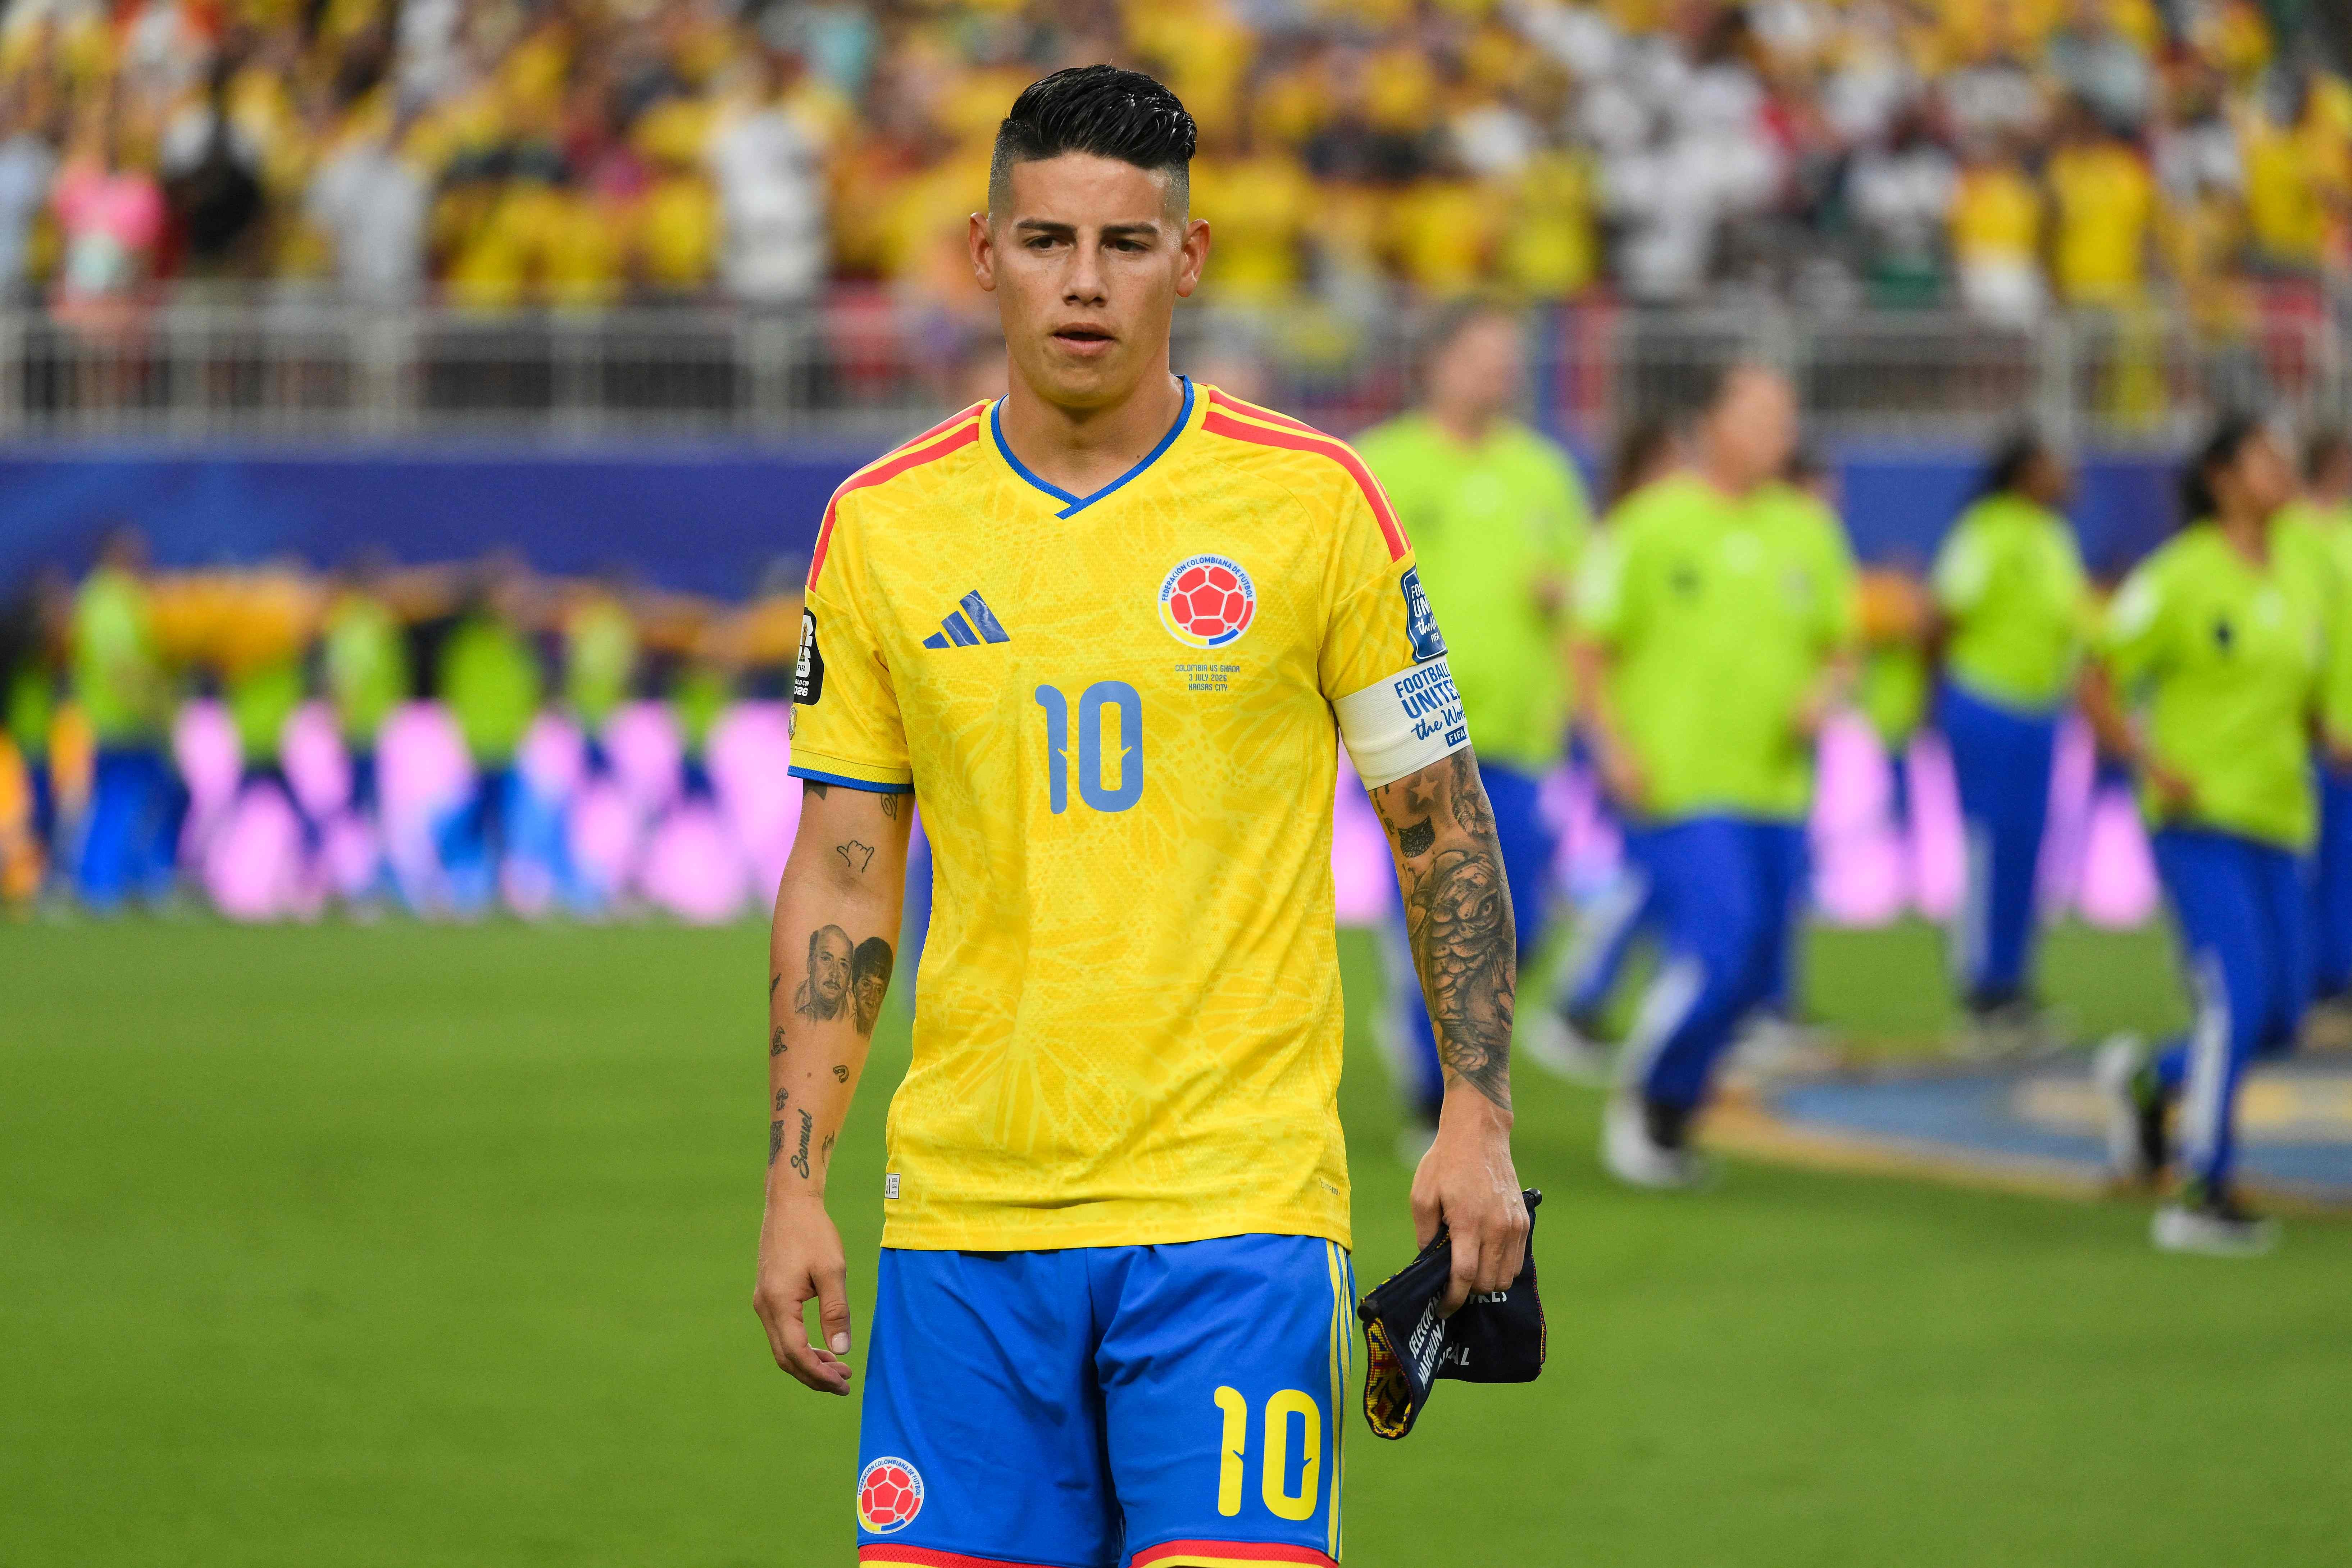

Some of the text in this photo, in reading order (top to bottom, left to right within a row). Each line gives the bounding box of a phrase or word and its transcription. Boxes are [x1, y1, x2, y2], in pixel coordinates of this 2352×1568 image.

[1187, 557, 1232, 569] COLOMBIANA
[1232, 566, 1241, 575] DE
[1430, 632, 1440, 642] FIFA
[794, 686, 808, 696] 026
[1394, 662, 1450, 698] FOOTBALL
[1411, 700, 1465, 740] the Worl
[1035, 680, 1143, 814] 10
[1448, 731, 1465, 744] FIFA
[791, 1109, 812, 1178] Samuel
[875, 1459, 908, 1470] COLOMBIANA
[1214, 1386, 1321, 1521] 10
